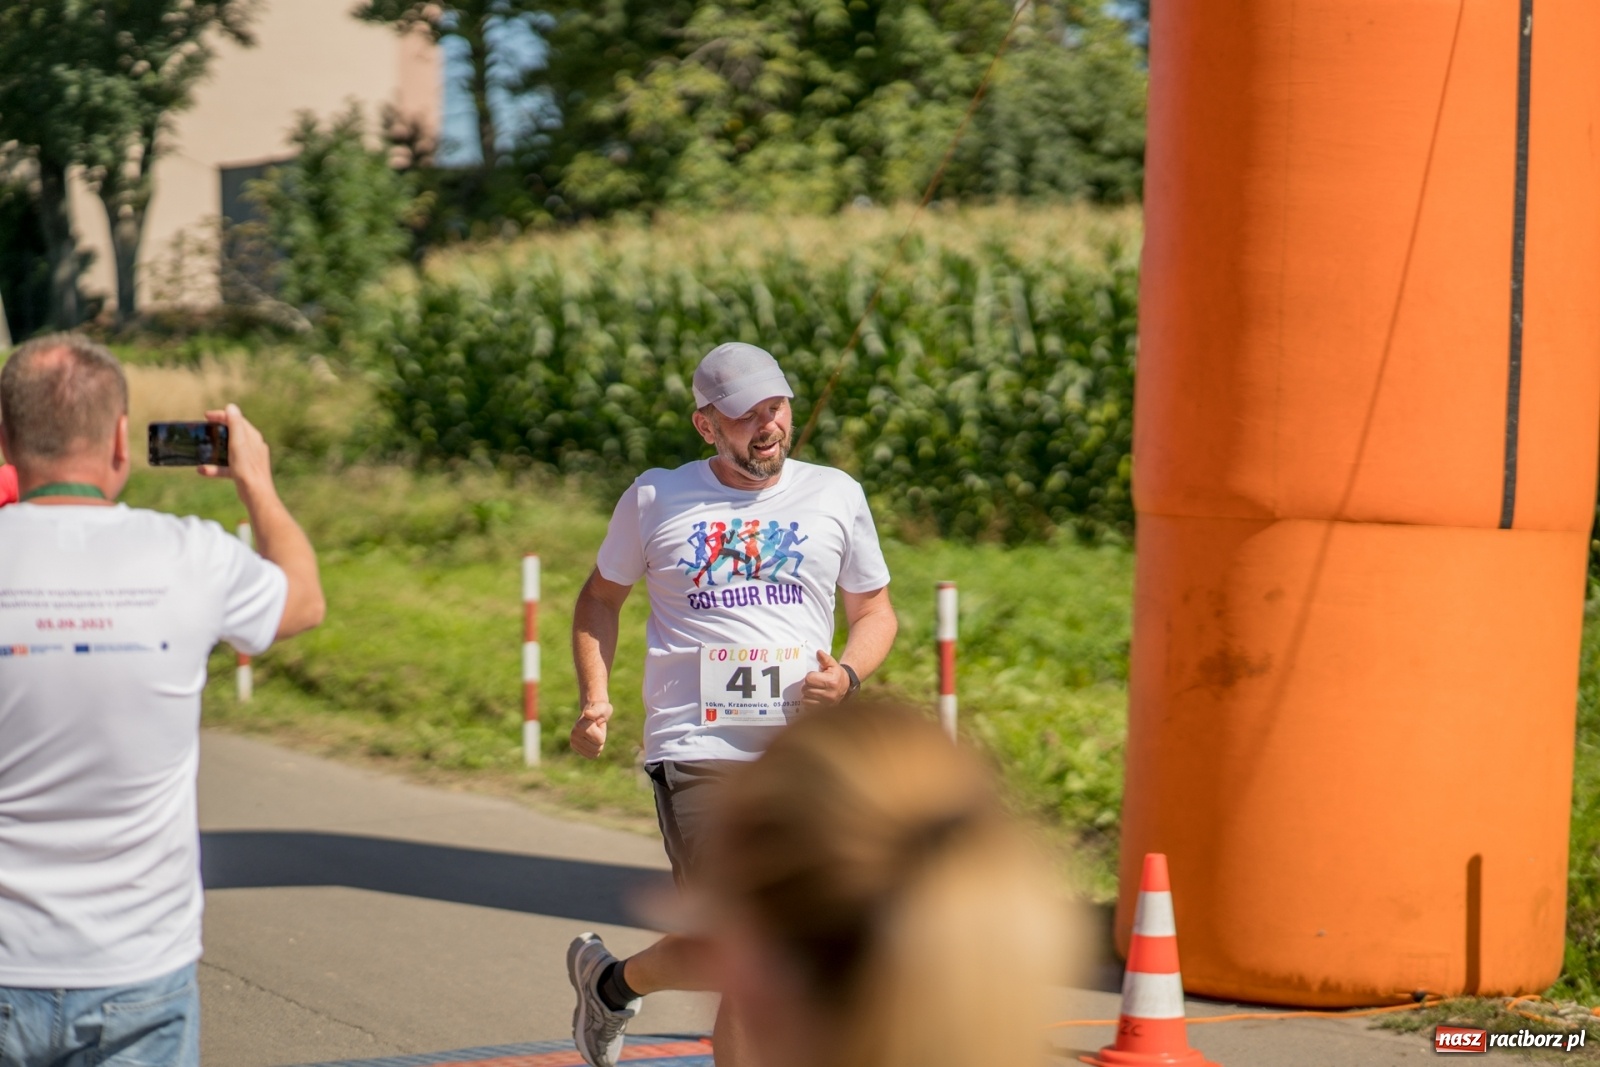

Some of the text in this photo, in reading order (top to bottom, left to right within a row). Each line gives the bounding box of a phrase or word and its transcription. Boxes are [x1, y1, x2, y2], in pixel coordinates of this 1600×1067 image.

[687, 583, 803, 610] COLOUR RUN
[709, 647, 800, 663] COLOUR RUN
[726, 665, 780, 699] 41
